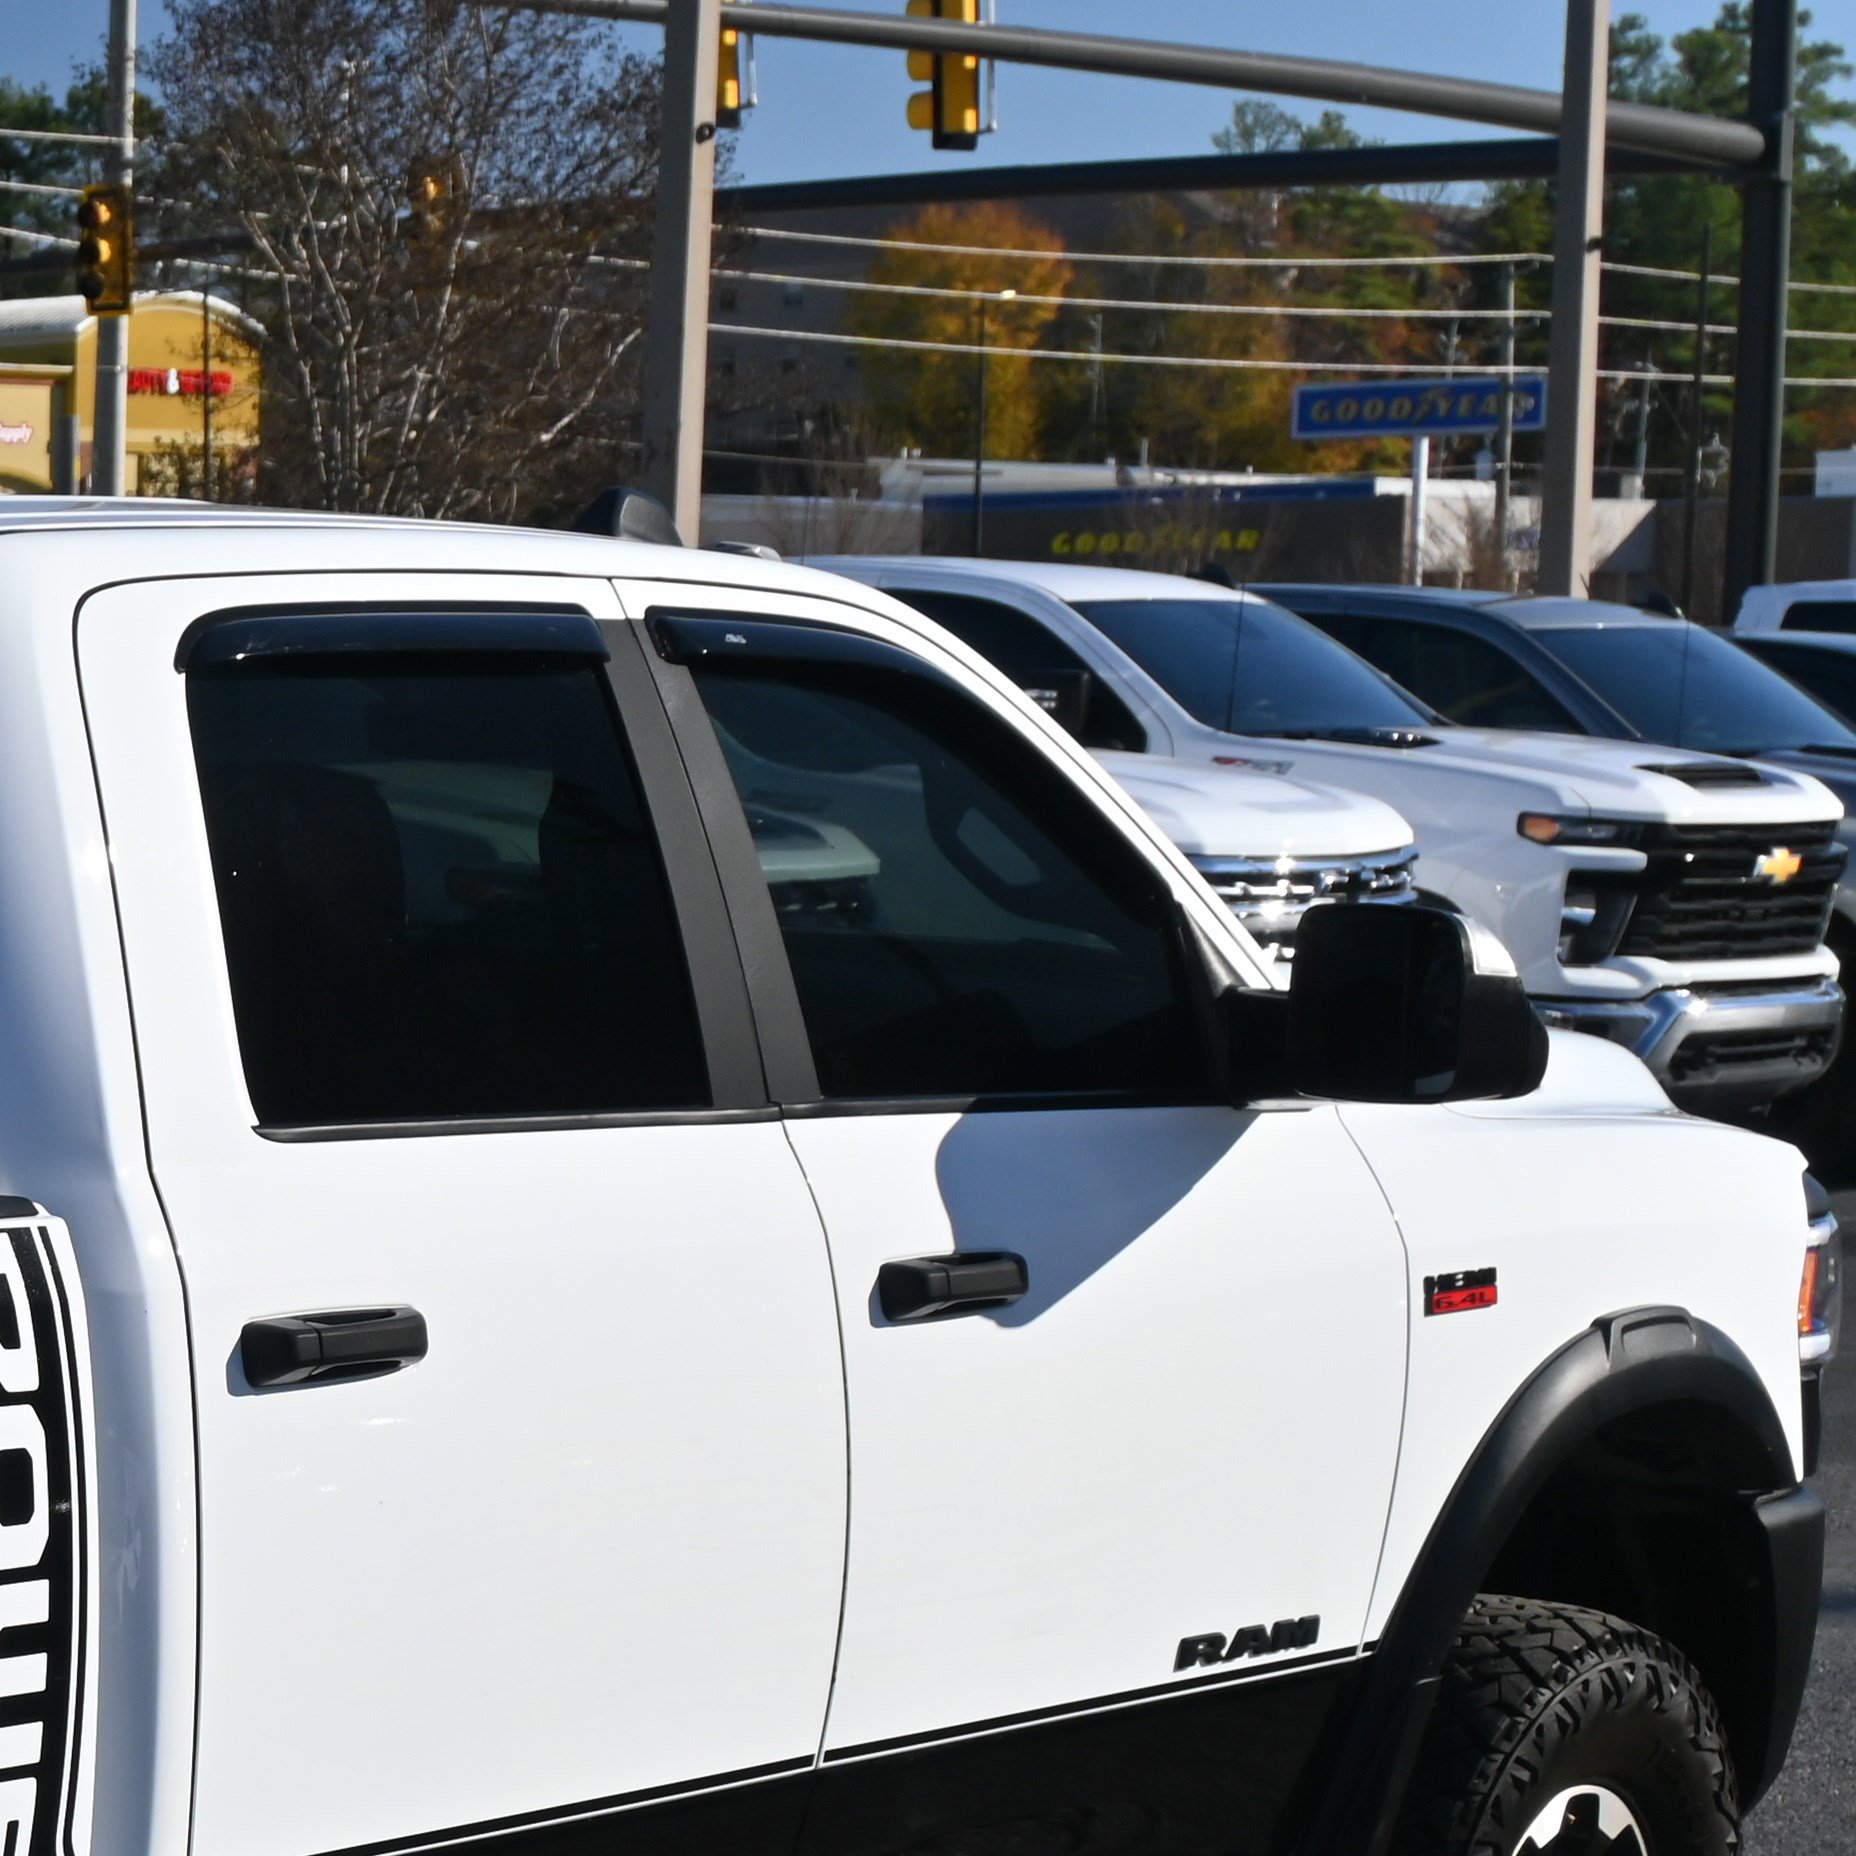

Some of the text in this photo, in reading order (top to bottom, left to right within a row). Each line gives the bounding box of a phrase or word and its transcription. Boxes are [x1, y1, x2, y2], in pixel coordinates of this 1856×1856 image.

[1310, 388, 1536, 424] GOODYEAR
[1433, 1290, 1495, 1310] 6.4L
[1173, 1614, 1320, 1673] RAM
